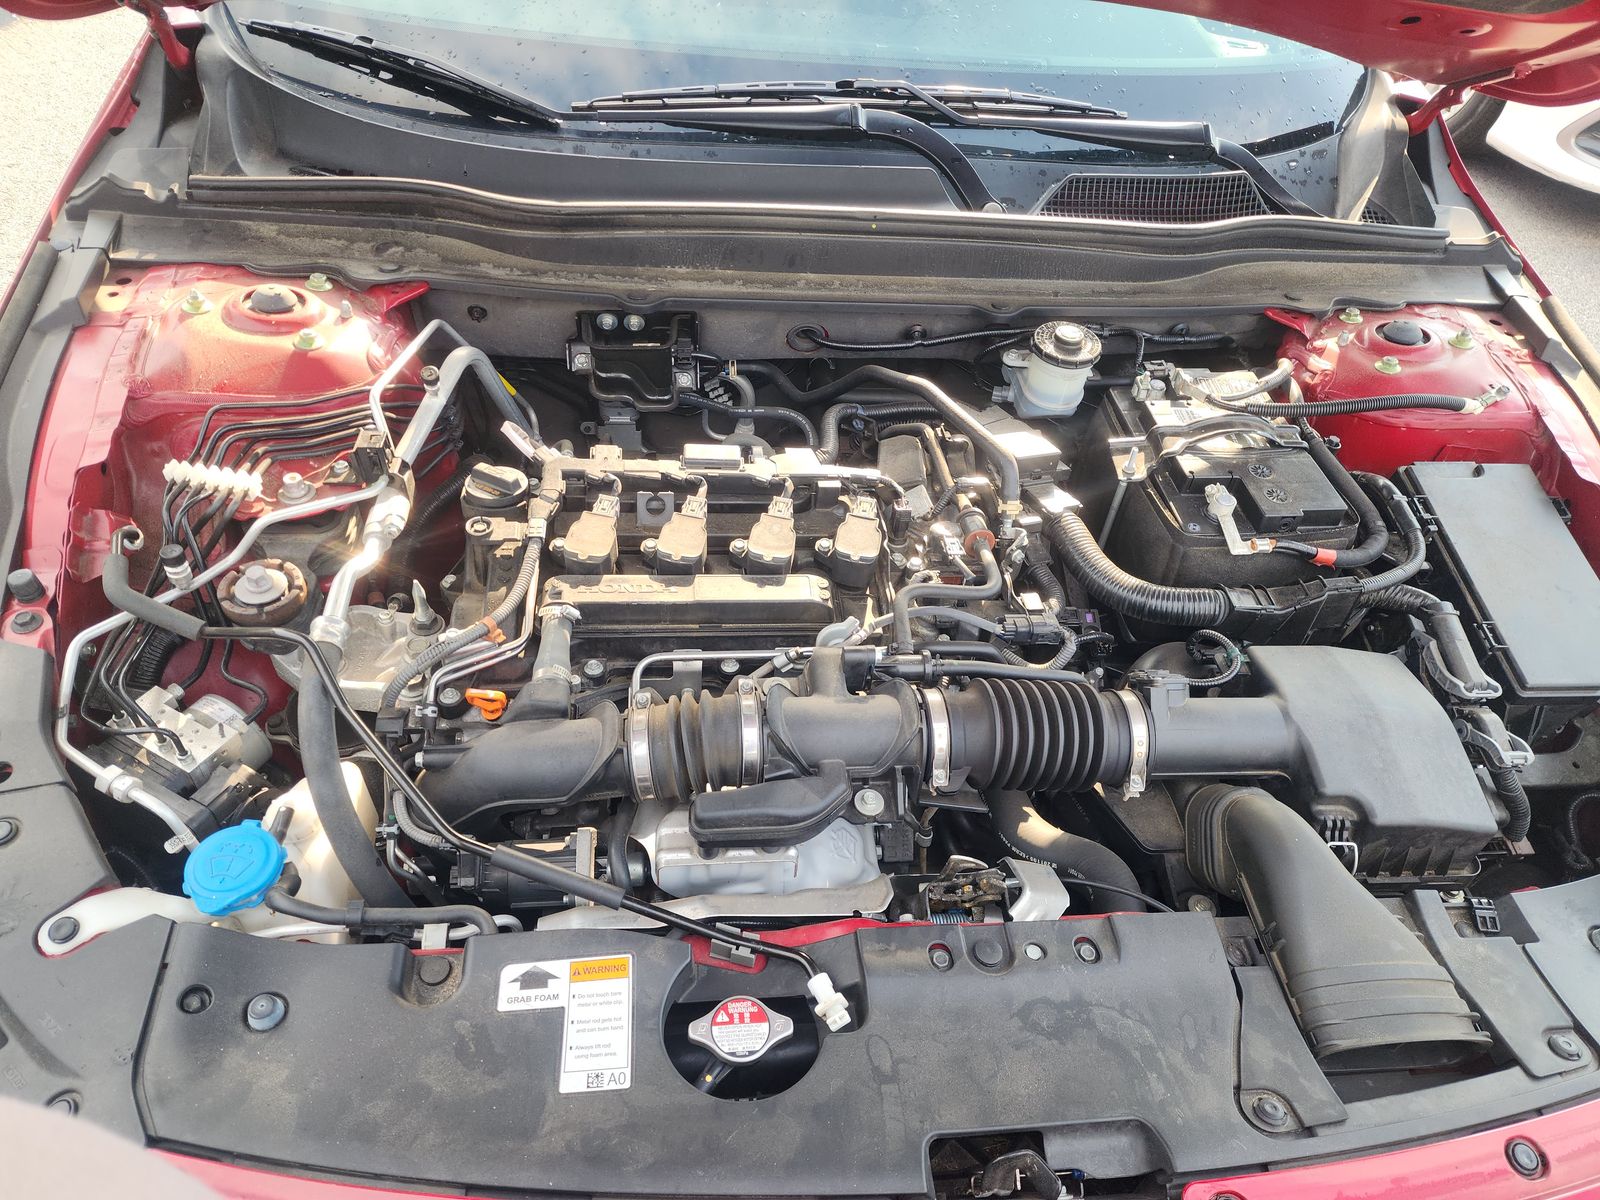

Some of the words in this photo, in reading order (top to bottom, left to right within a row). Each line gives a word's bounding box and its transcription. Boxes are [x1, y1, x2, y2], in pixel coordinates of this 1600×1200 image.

[577, 583, 678, 594] HONDA
[582, 964, 627, 975] WARNING
[506, 995, 532, 1005] GRAB
[534, 993, 560, 1002] FOAM
[727, 1001, 752, 1009] DANGER
